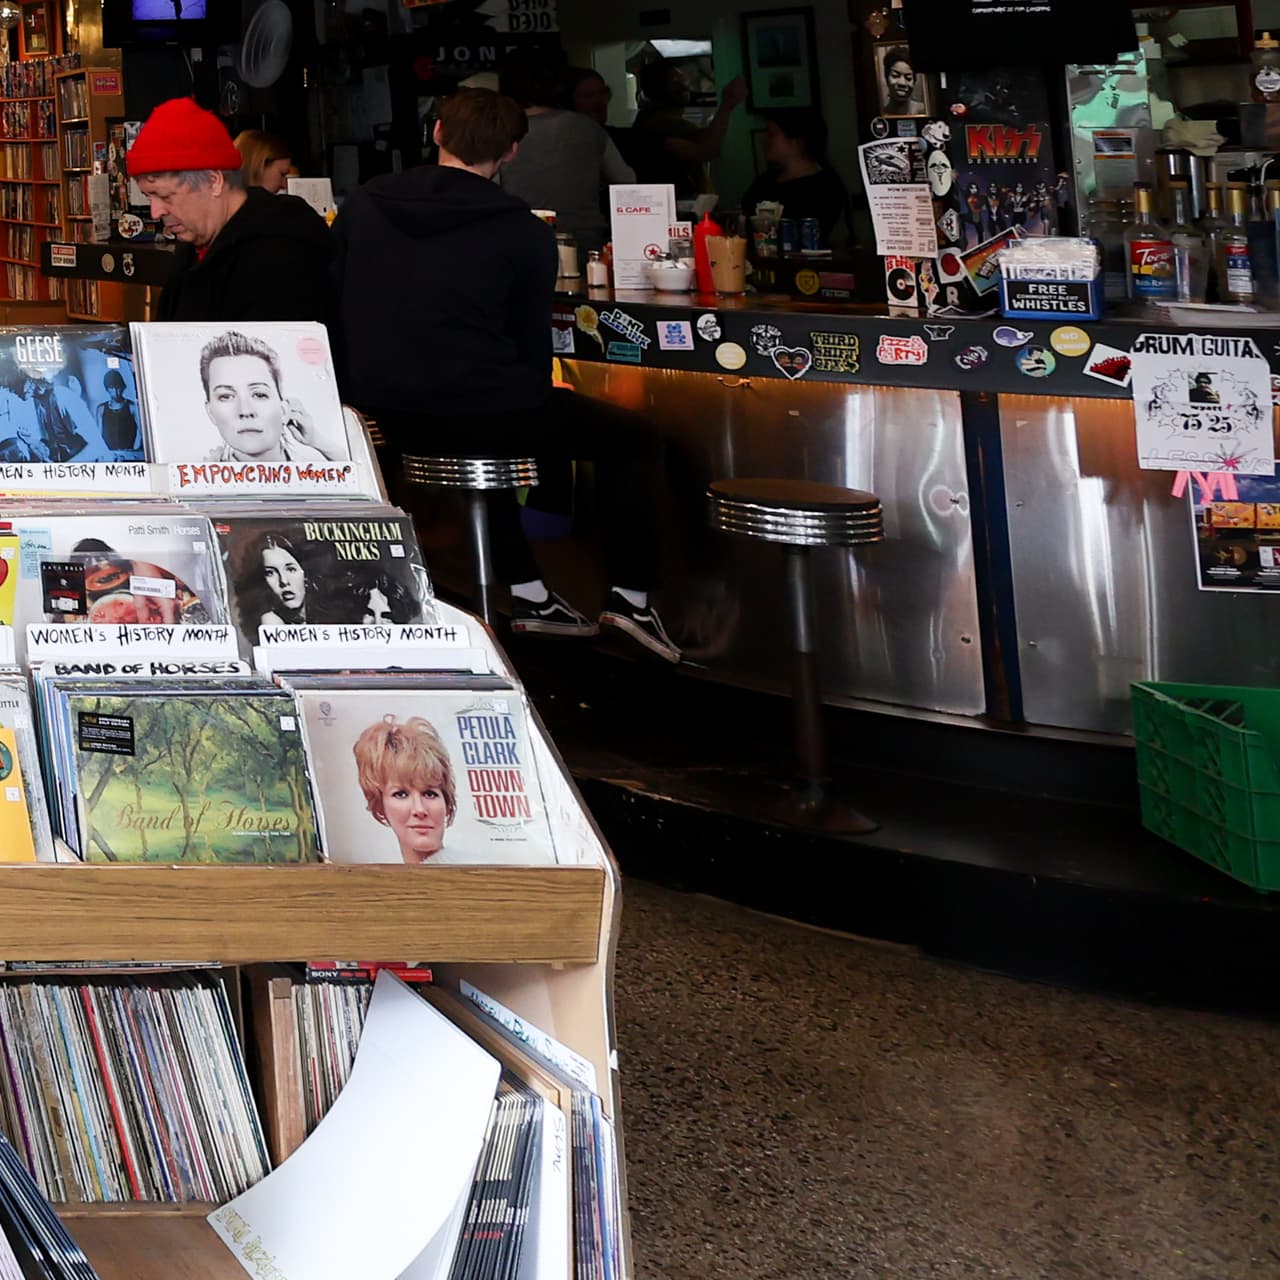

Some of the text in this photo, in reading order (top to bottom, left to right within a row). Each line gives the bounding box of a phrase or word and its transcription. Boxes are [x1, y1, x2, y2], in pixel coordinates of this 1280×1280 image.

[964, 123, 1041, 159] KISS
[1028, 284, 1067, 295] FREE
[1012, 299, 1087, 311] WHISTLES
[15, 335, 64, 362] GEESE
[811, 332, 858, 346] THIRD
[1201, 336, 1261, 359] GUITA
[43, 465, 99, 480] HISTORY
[106, 463, 147, 480] MONTH
[304, 522, 403, 541] BUCKINGHAM
[335, 542, 380, 560] NICKS
[116, 624, 176, 645] HISTORY
[182, 625, 231, 643] MONTH
[339, 626, 391, 644] HISTORY
[400, 627, 457, 642] MONTH
[53, 660, 242, 676] BAND OF HORSES
[456, 714, 518, 740] PETULA
[461, 740, 519, 766] CLARK
[468, 768, 524, 792] DOWN
[474, 793, 531, 819] TOWN
